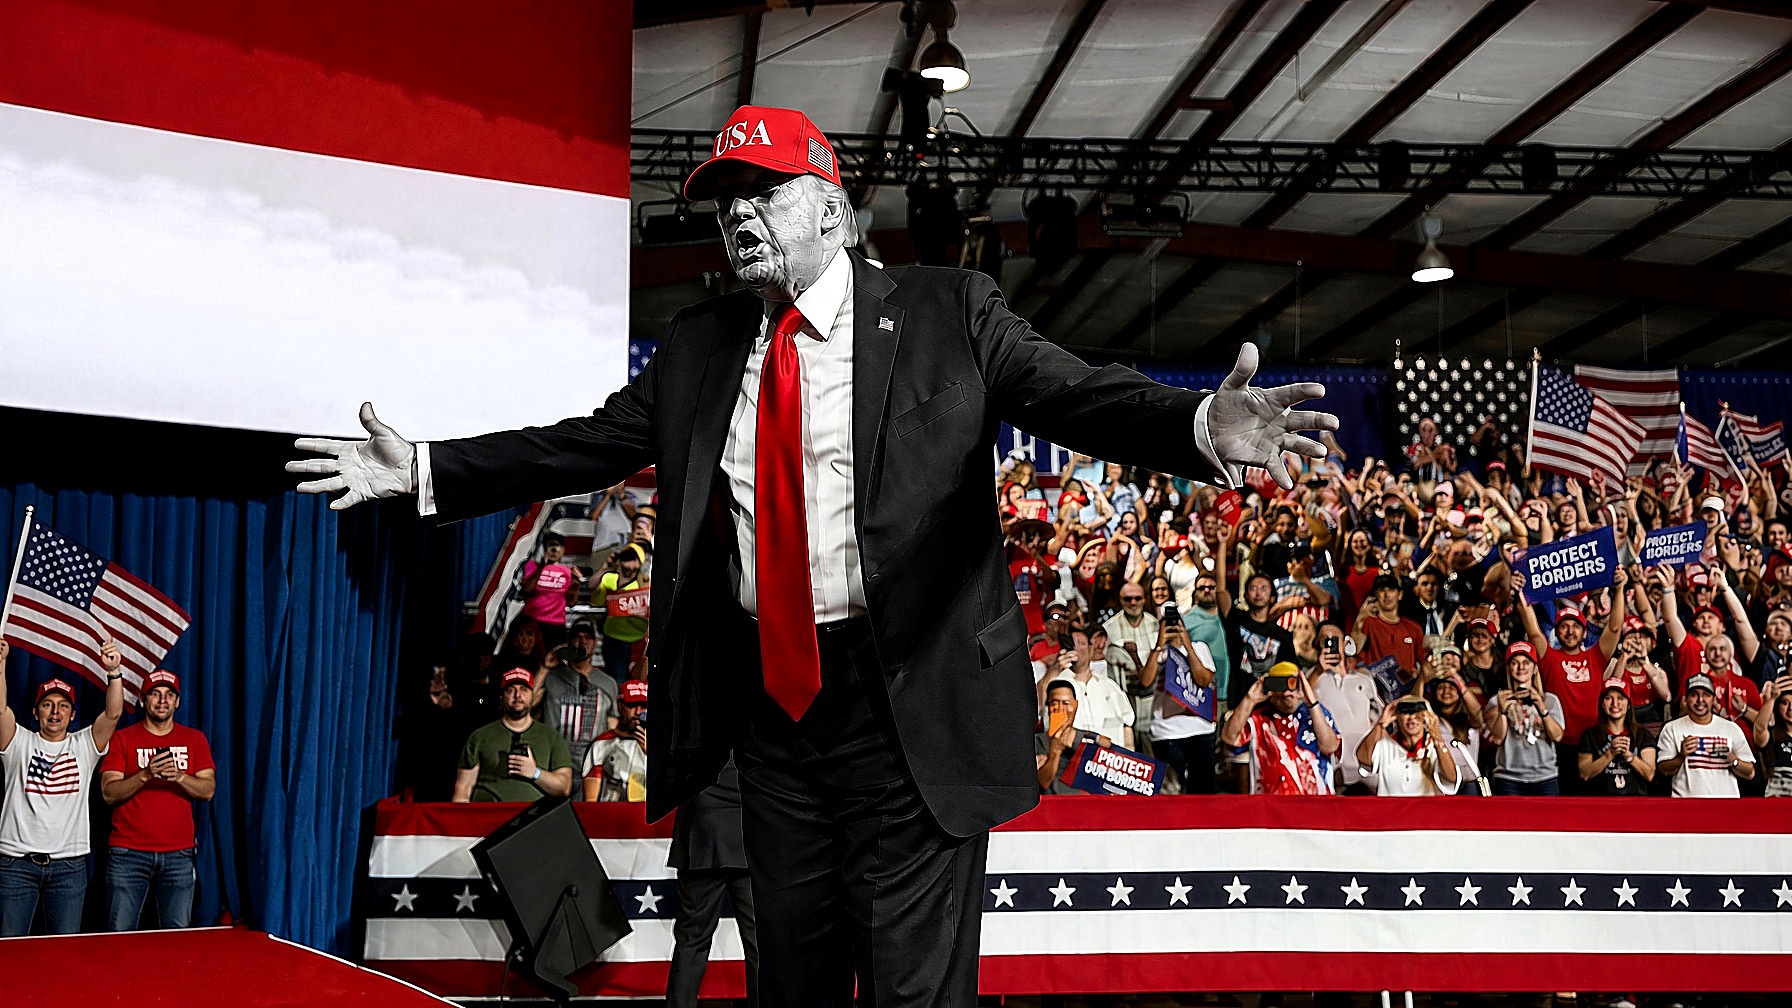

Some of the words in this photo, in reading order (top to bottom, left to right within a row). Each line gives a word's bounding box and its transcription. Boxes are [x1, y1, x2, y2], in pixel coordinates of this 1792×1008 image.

[716, 119, 773, 157] USA
[1528, 540, 1598, 574] PROTECT
[1531, 556, 1606, 590] BORDERS
[1084, 760, 1107, 779] OUR
[1106, 767, 1155, 797] BORDERS
[1097, 749, 1152, 779] PROTECT
